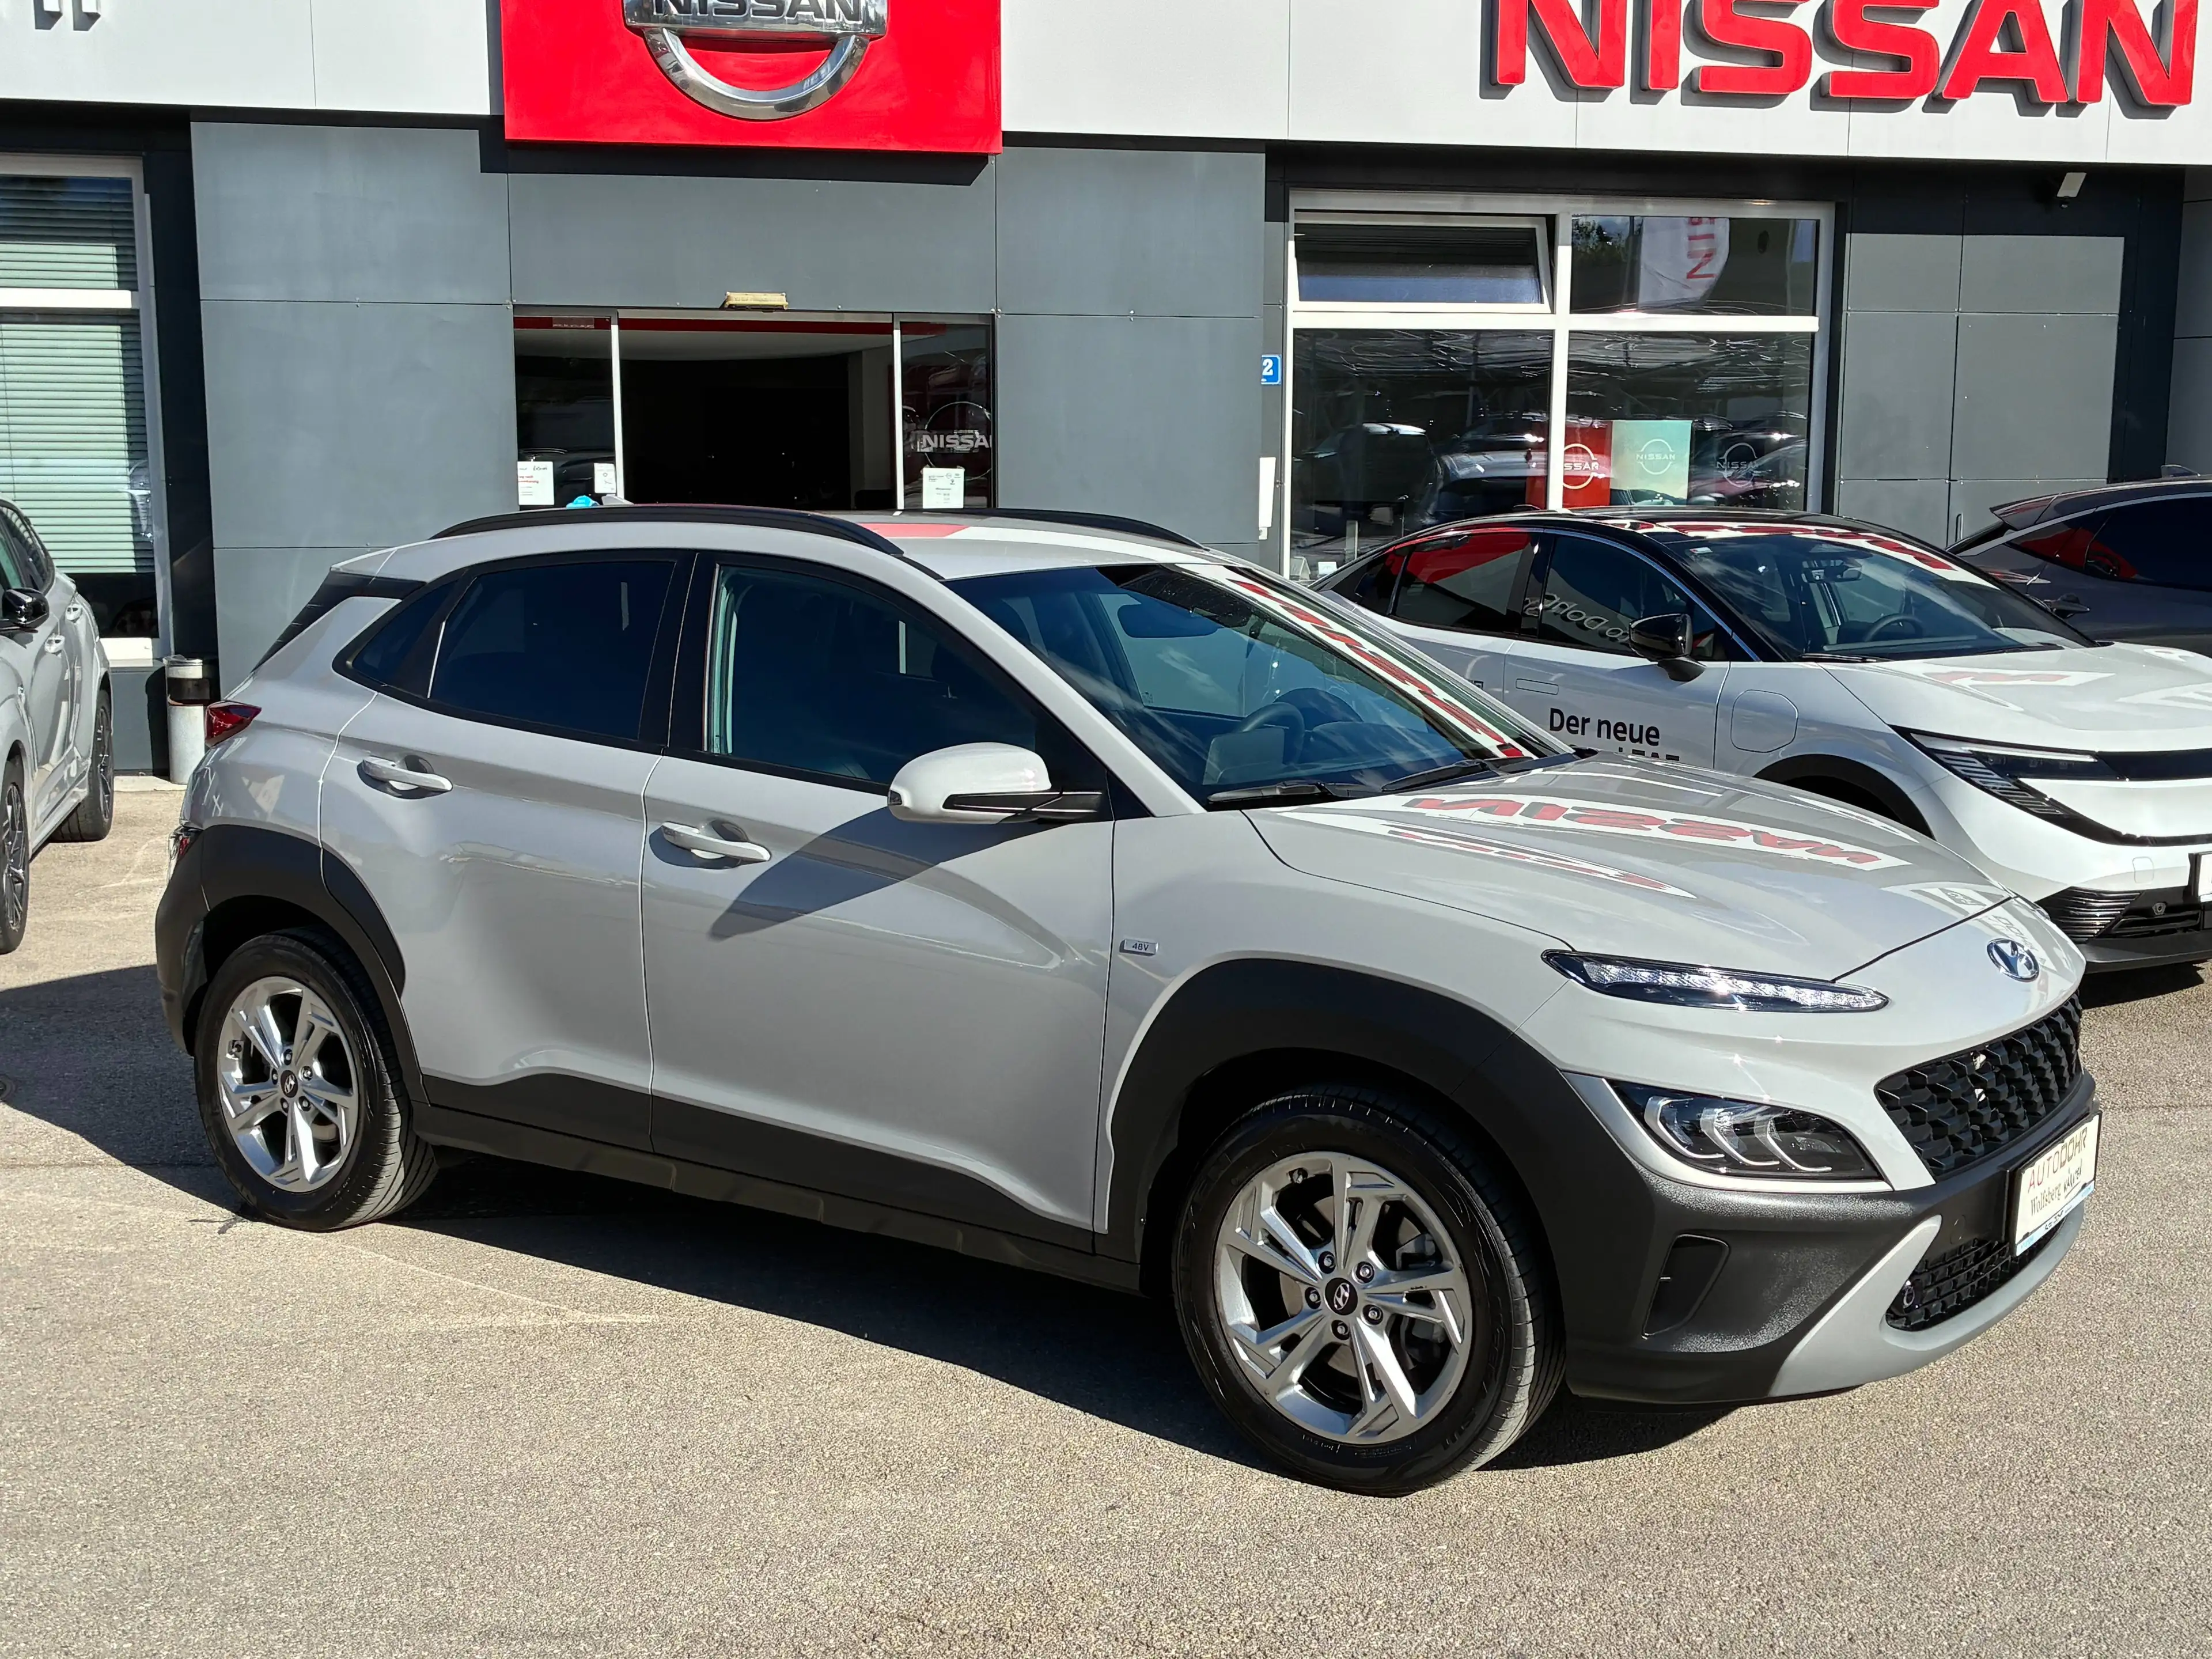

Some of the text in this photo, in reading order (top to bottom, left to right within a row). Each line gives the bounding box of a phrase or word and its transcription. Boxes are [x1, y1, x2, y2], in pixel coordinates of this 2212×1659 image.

[1493, 0, 2197, 107] NISSAN
[922, 434, 991, 448] NISSA
[1550, 707, 1660, 747] Der neue
[1132, 942, 1149, 951] 48V
